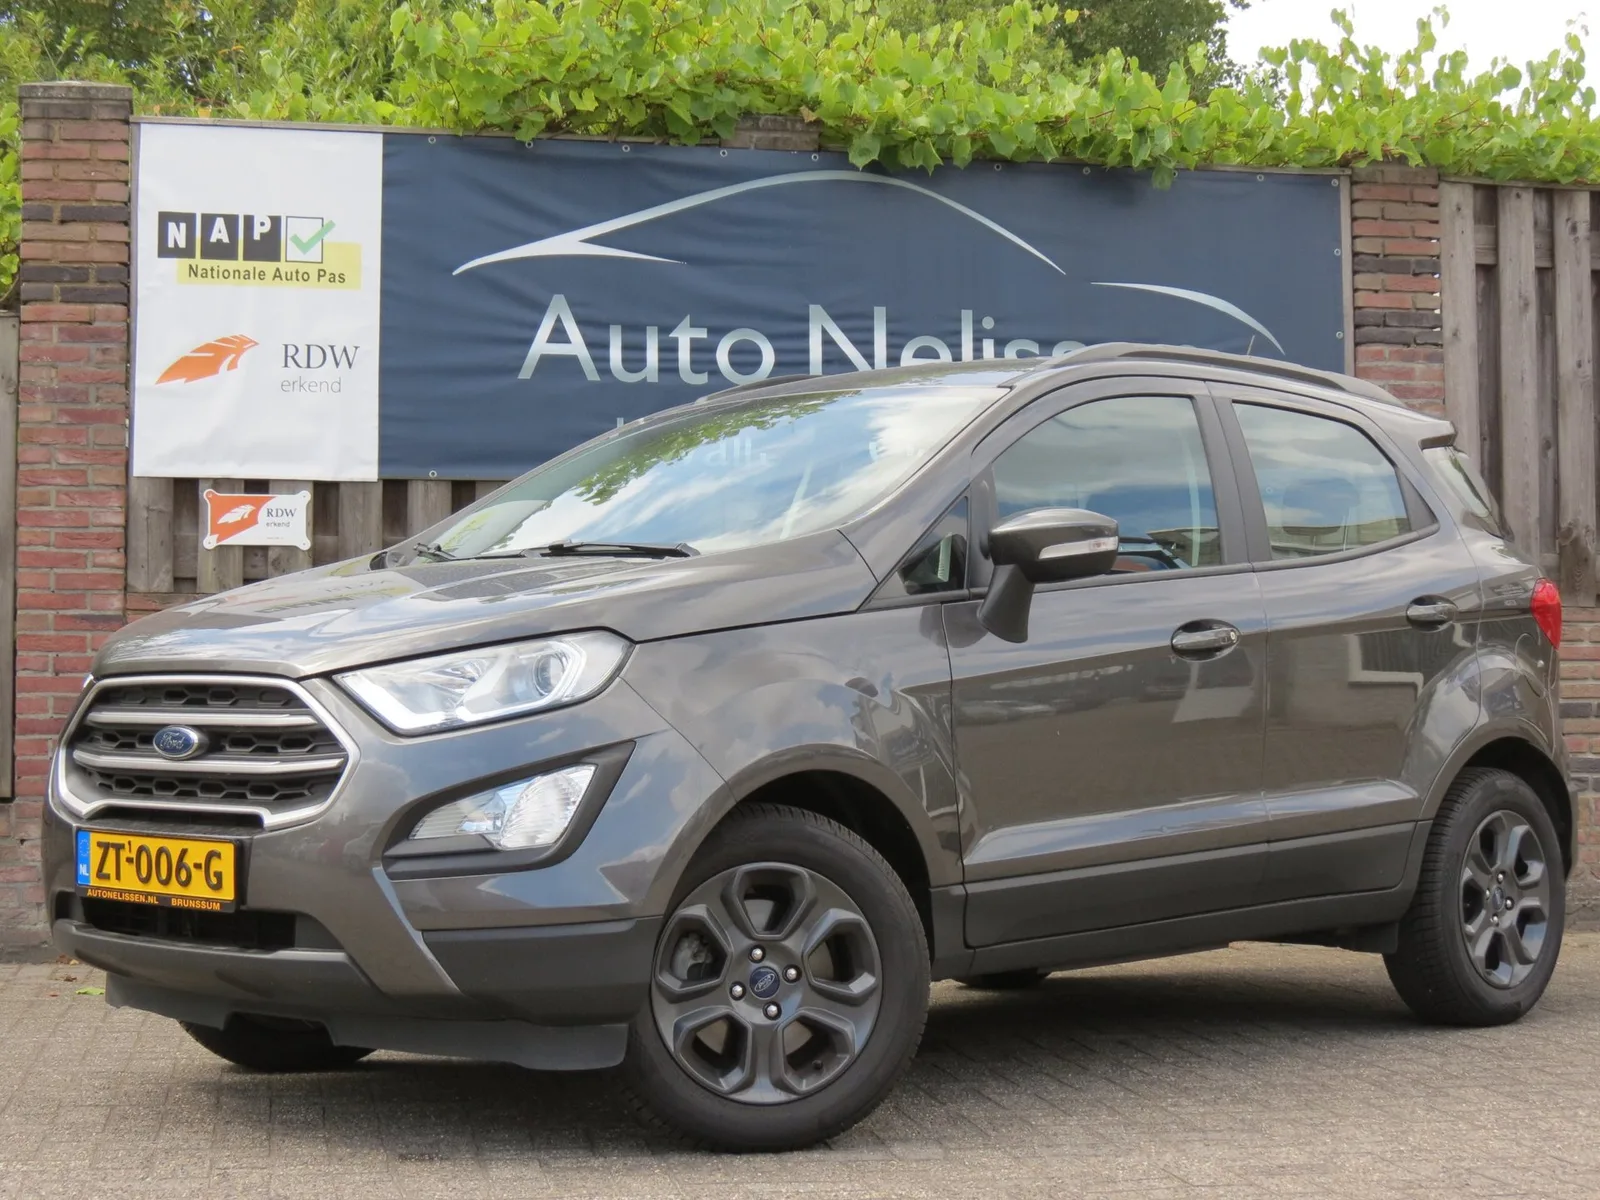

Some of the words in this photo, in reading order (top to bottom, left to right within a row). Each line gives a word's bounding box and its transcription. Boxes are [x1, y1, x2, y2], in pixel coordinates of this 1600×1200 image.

[168, 215, 271, 248] NAP
[188, 263, 266, 281] Nationale
[272, 267, 310, 282] Auto
[317, 268, 346, 283] Pas
[517, 294, 776, 386] Auto
[282, 343, 360, 369] RDW
[280, 376, 342, 393] erkend
[266, 508, 296, 518] RDW
[79, 863, 89, 877] NL
[87, 888, 159, 904] AUTONELISSEN.NL
[171, 898, 221, 911] BRUNSSUM
